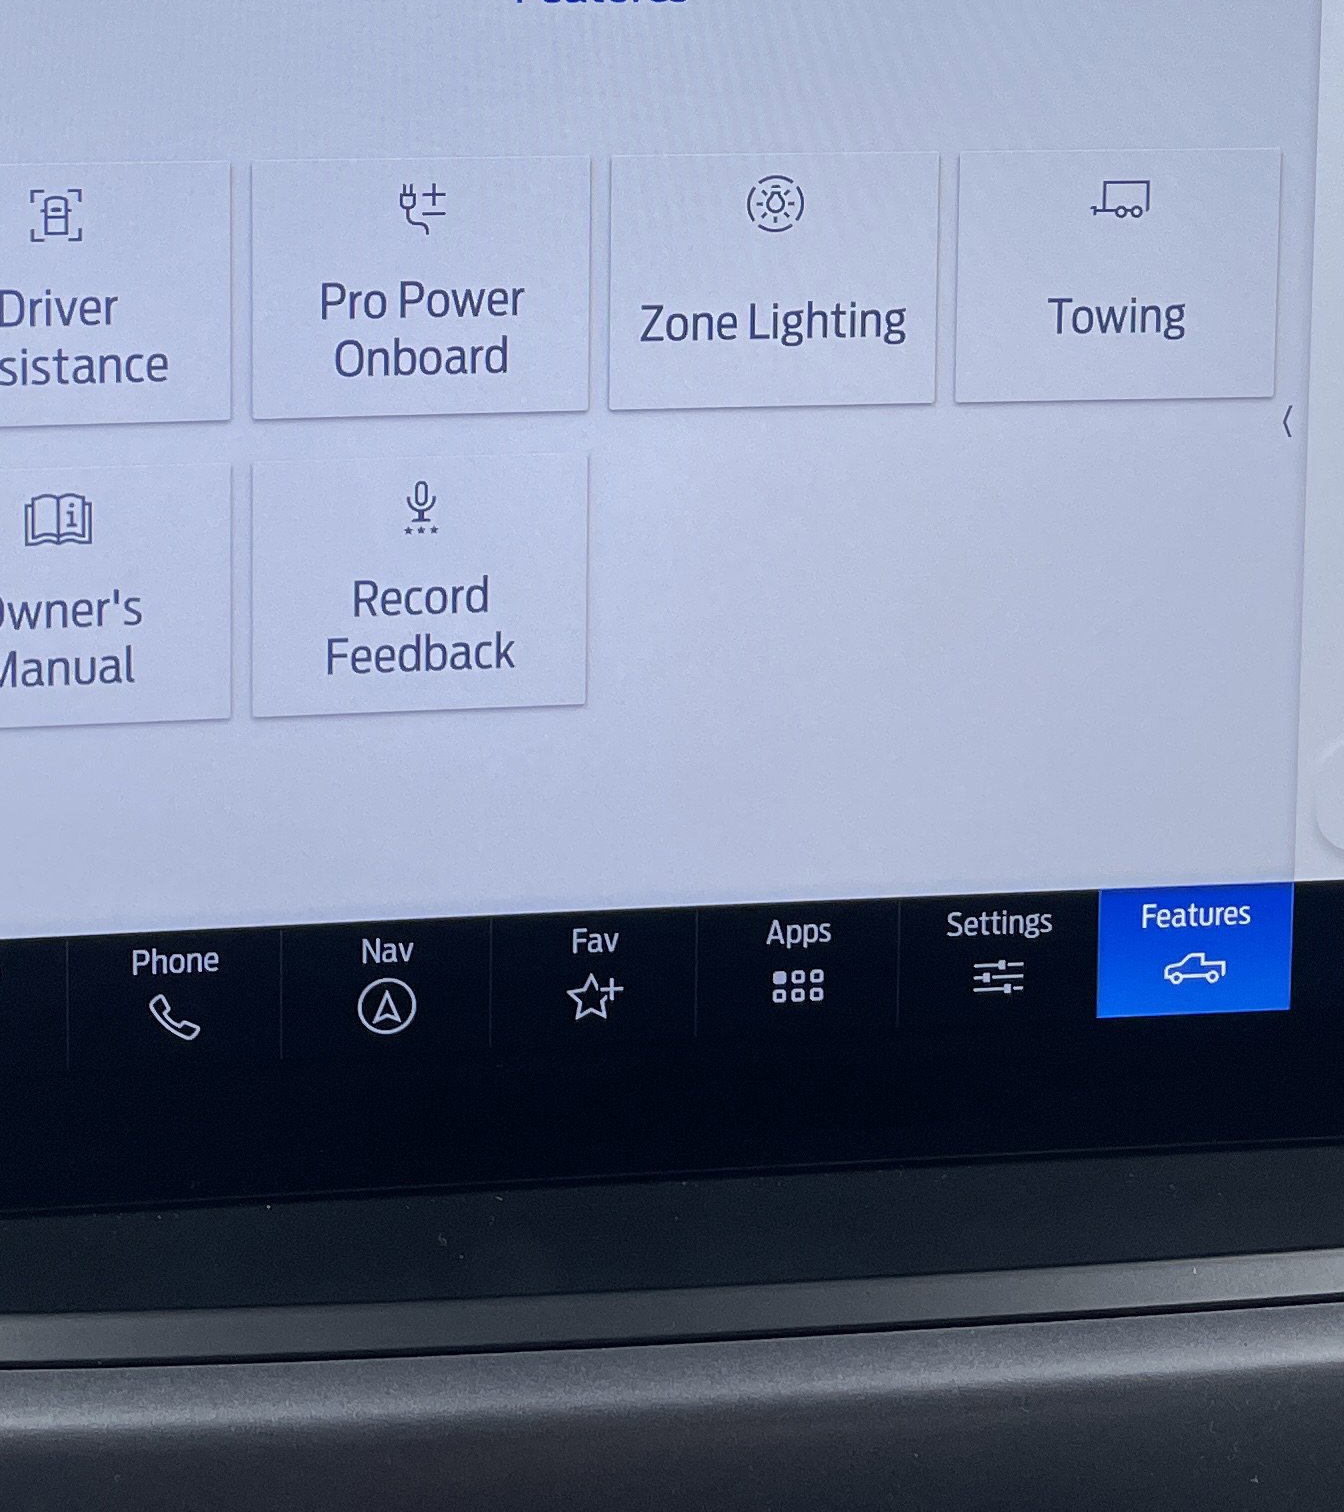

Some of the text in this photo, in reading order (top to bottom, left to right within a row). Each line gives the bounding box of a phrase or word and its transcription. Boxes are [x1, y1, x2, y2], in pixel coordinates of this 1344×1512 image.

[321, 280, 526, 321] Pro Power
[1047, 296, 1186, 341] Towing
[640, 300, 907, 347] Zone Lighting
[335, 334, 508, 378] Onboard
[353, 574, 489, 618] Record
[327, 630, 516, 676] Feedback
[946, 909, 1053, 939] Settings
[1141, 902, 1251, 929] Features
[361, 937, 415, 965] Nav
[572, 927, 620, 955] Fav
[765, 919, 832, 950] Apps
[132, 947, 219, 976] Phone
